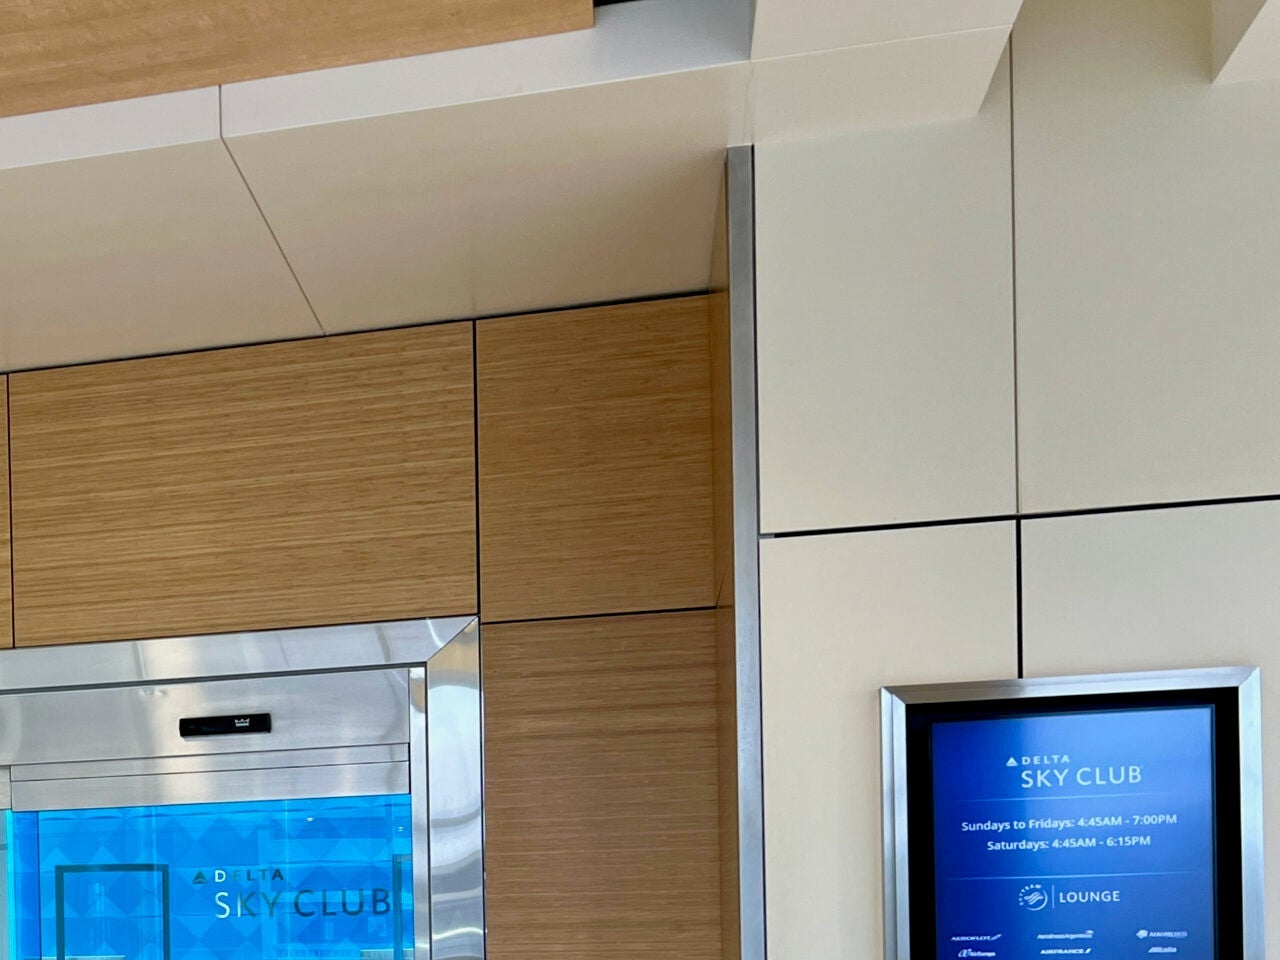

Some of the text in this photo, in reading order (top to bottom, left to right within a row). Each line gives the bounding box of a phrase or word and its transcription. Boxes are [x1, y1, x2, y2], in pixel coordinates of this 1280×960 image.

[1021, 754, 1070, 765] DELTA
[1021, 765, 1142, 789] SKY CLUB
[961, 820, 1011, 833] Sundays
[1013, 820, 1026, 830] to
[1029, 818, 1074, 831] Fridays:
[1077, 816, 1123, 827] 4:45AM
[1132, 814, 1178, 825] 7:00PM
[987, 839, 1049, 852] Saturdays:
[1052, 837, 1096, 849] 4:45AM
[1106, 836, 1151, 847] 6:15PM
[214, 868, 285, 883] DELTA
[214, 888, 391, 919] SKY CLUB
[1059, 890, 1120, 903] LOUNGE
